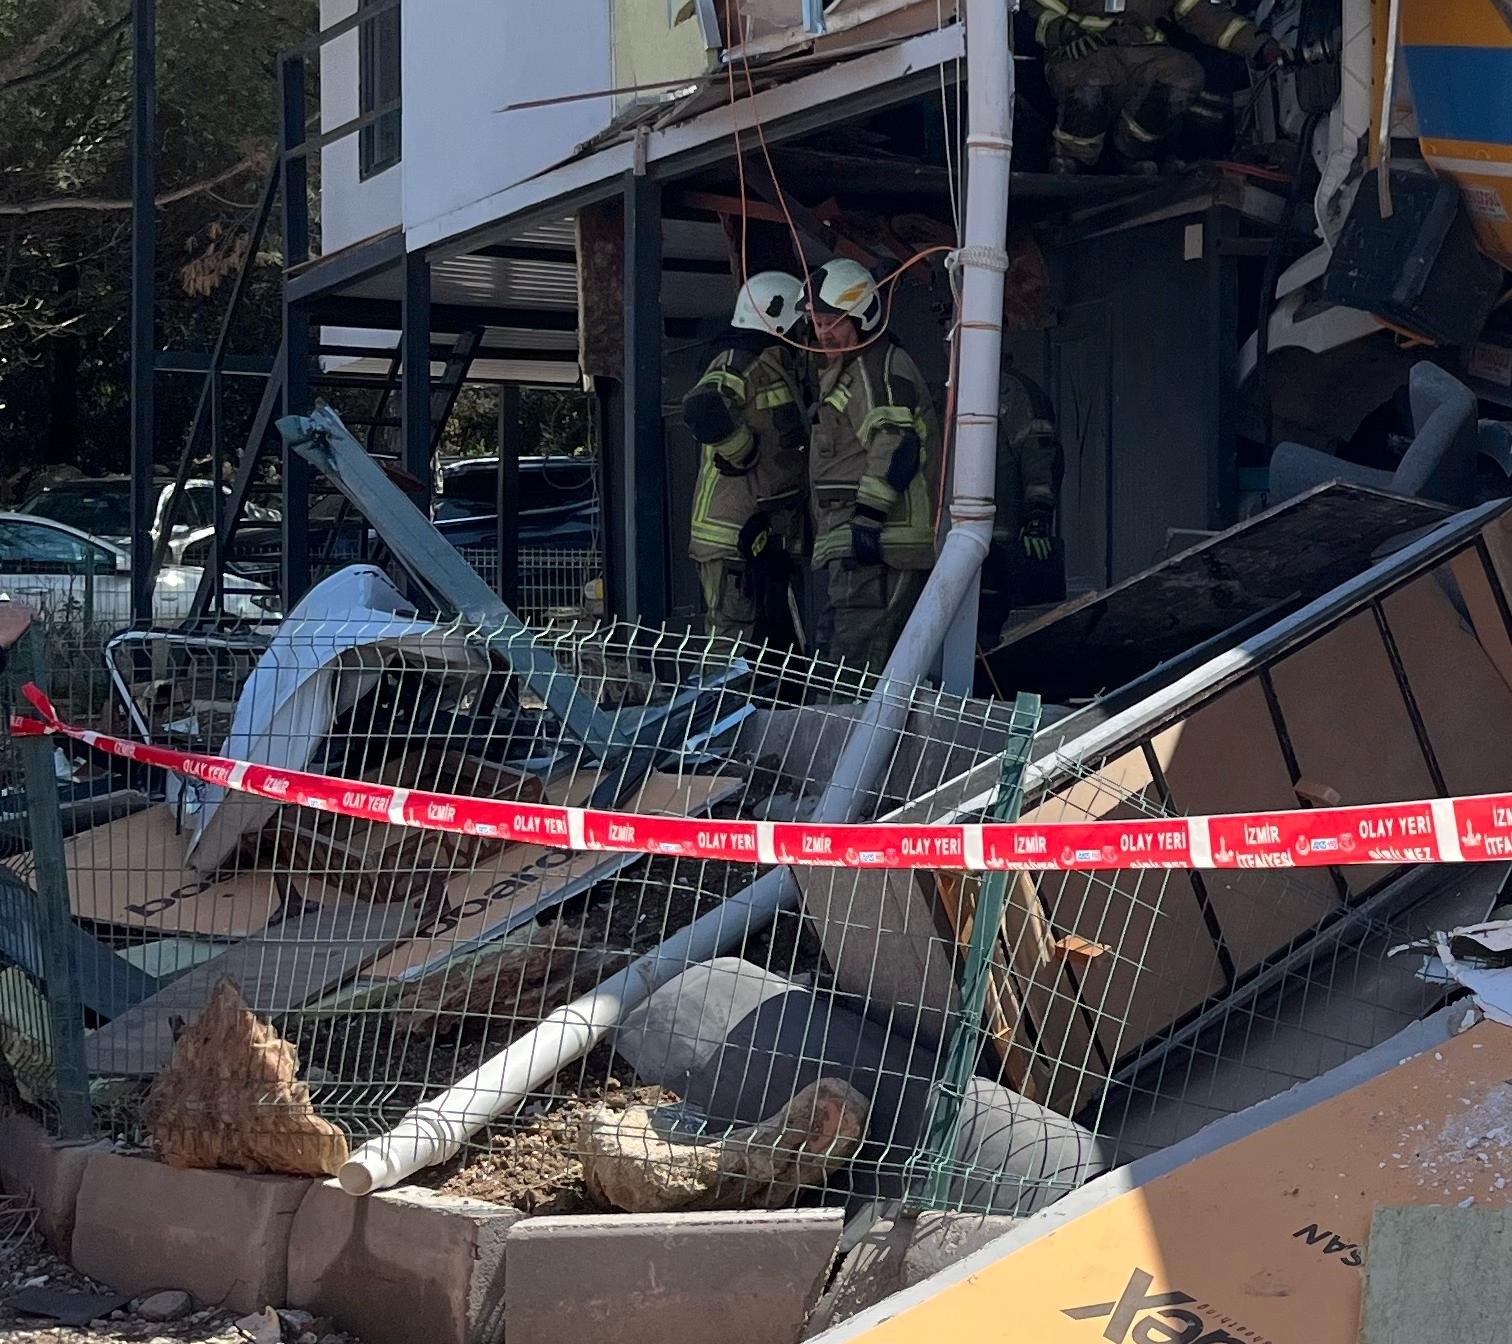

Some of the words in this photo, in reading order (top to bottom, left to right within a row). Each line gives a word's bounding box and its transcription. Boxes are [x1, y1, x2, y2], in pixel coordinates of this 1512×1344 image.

[183, 759, 207, 776] OLAY
[208, 762, 229, 781] YERİ
[264, 775, 289, 794] İZMİR
[343, 792, 365, 808] OLAY
[367, 794, 390, 812] YERİ
[427, 801, 456, 822] İZMİR
[513, 815, 540, 832] OLAY
[543, 818, 567, 835] YERİ
[608, 821, 635, 843] İZMİR
[1243, 822, 1280, 845] İZMİR
[1358, 819, 1393, 839] OLAY
[1398, 810, 1432, 835] YERİ
[697, 832, 727, 849] OLAY
[730, 831, 756, 851] YERİ
[802, 833, 832, 854] İZMİR
[901, 838, 931, 855] OLAY
[934, 833, 961, 855] YERİ
[1013, 832, 1046, 854] İZMİR
[1120, 832, 1154, 852] OLAY
[1156, 826, 1186, 850] YERİ
[1293, 1222, 1366, 1267] SAN
